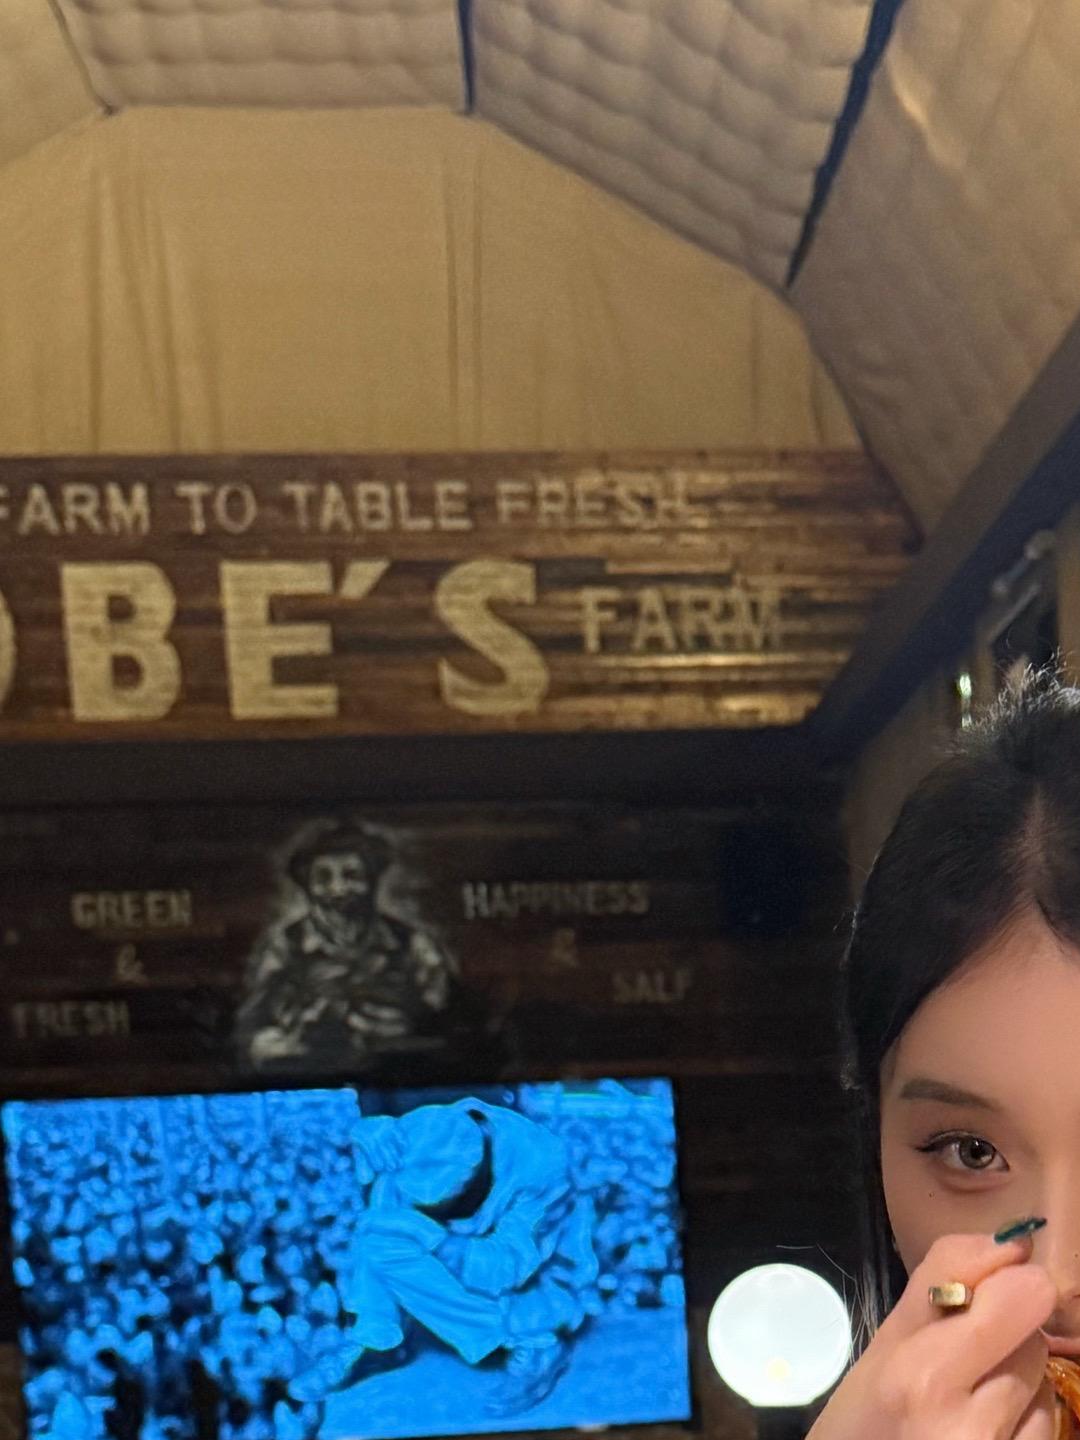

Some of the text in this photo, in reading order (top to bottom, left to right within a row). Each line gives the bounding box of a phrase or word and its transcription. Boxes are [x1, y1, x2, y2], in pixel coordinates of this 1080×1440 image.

[175, 482, 257, 535] TO
[283, 480, 473, 532] TABLE
[0, 558, 782, 722] BE'S FARM
[71, 890, 192, 929] GREEN
[115, 944, 148, 983] &
